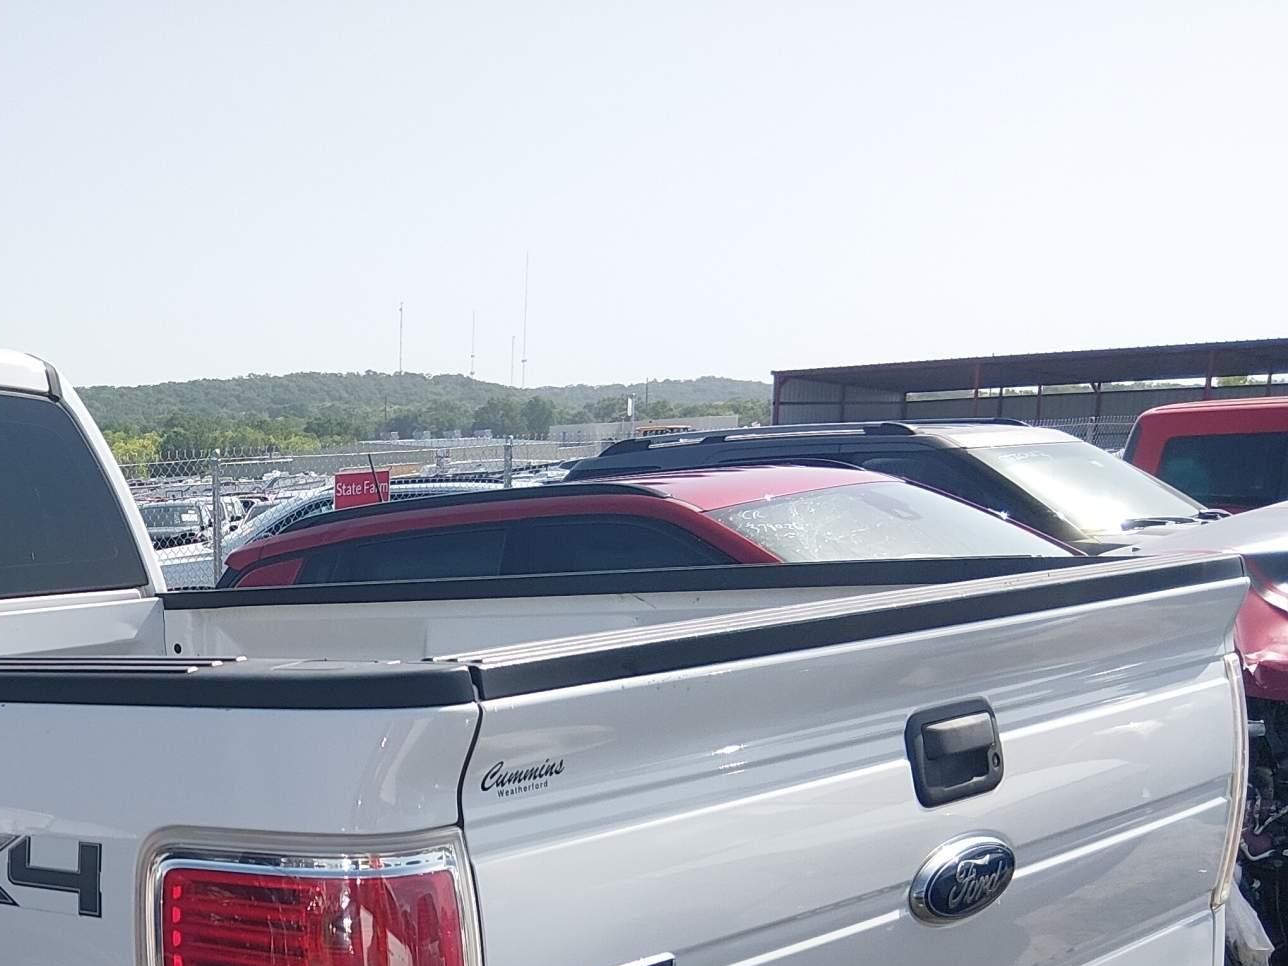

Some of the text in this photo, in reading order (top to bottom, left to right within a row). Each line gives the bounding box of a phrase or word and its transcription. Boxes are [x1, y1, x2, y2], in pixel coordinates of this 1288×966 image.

[336, 482, 362, 497] State
[480, 758, 566, 792] Cummins
[497, 780, 549, 799] Weatherford
[948, 854, 1004, 909] Ford
